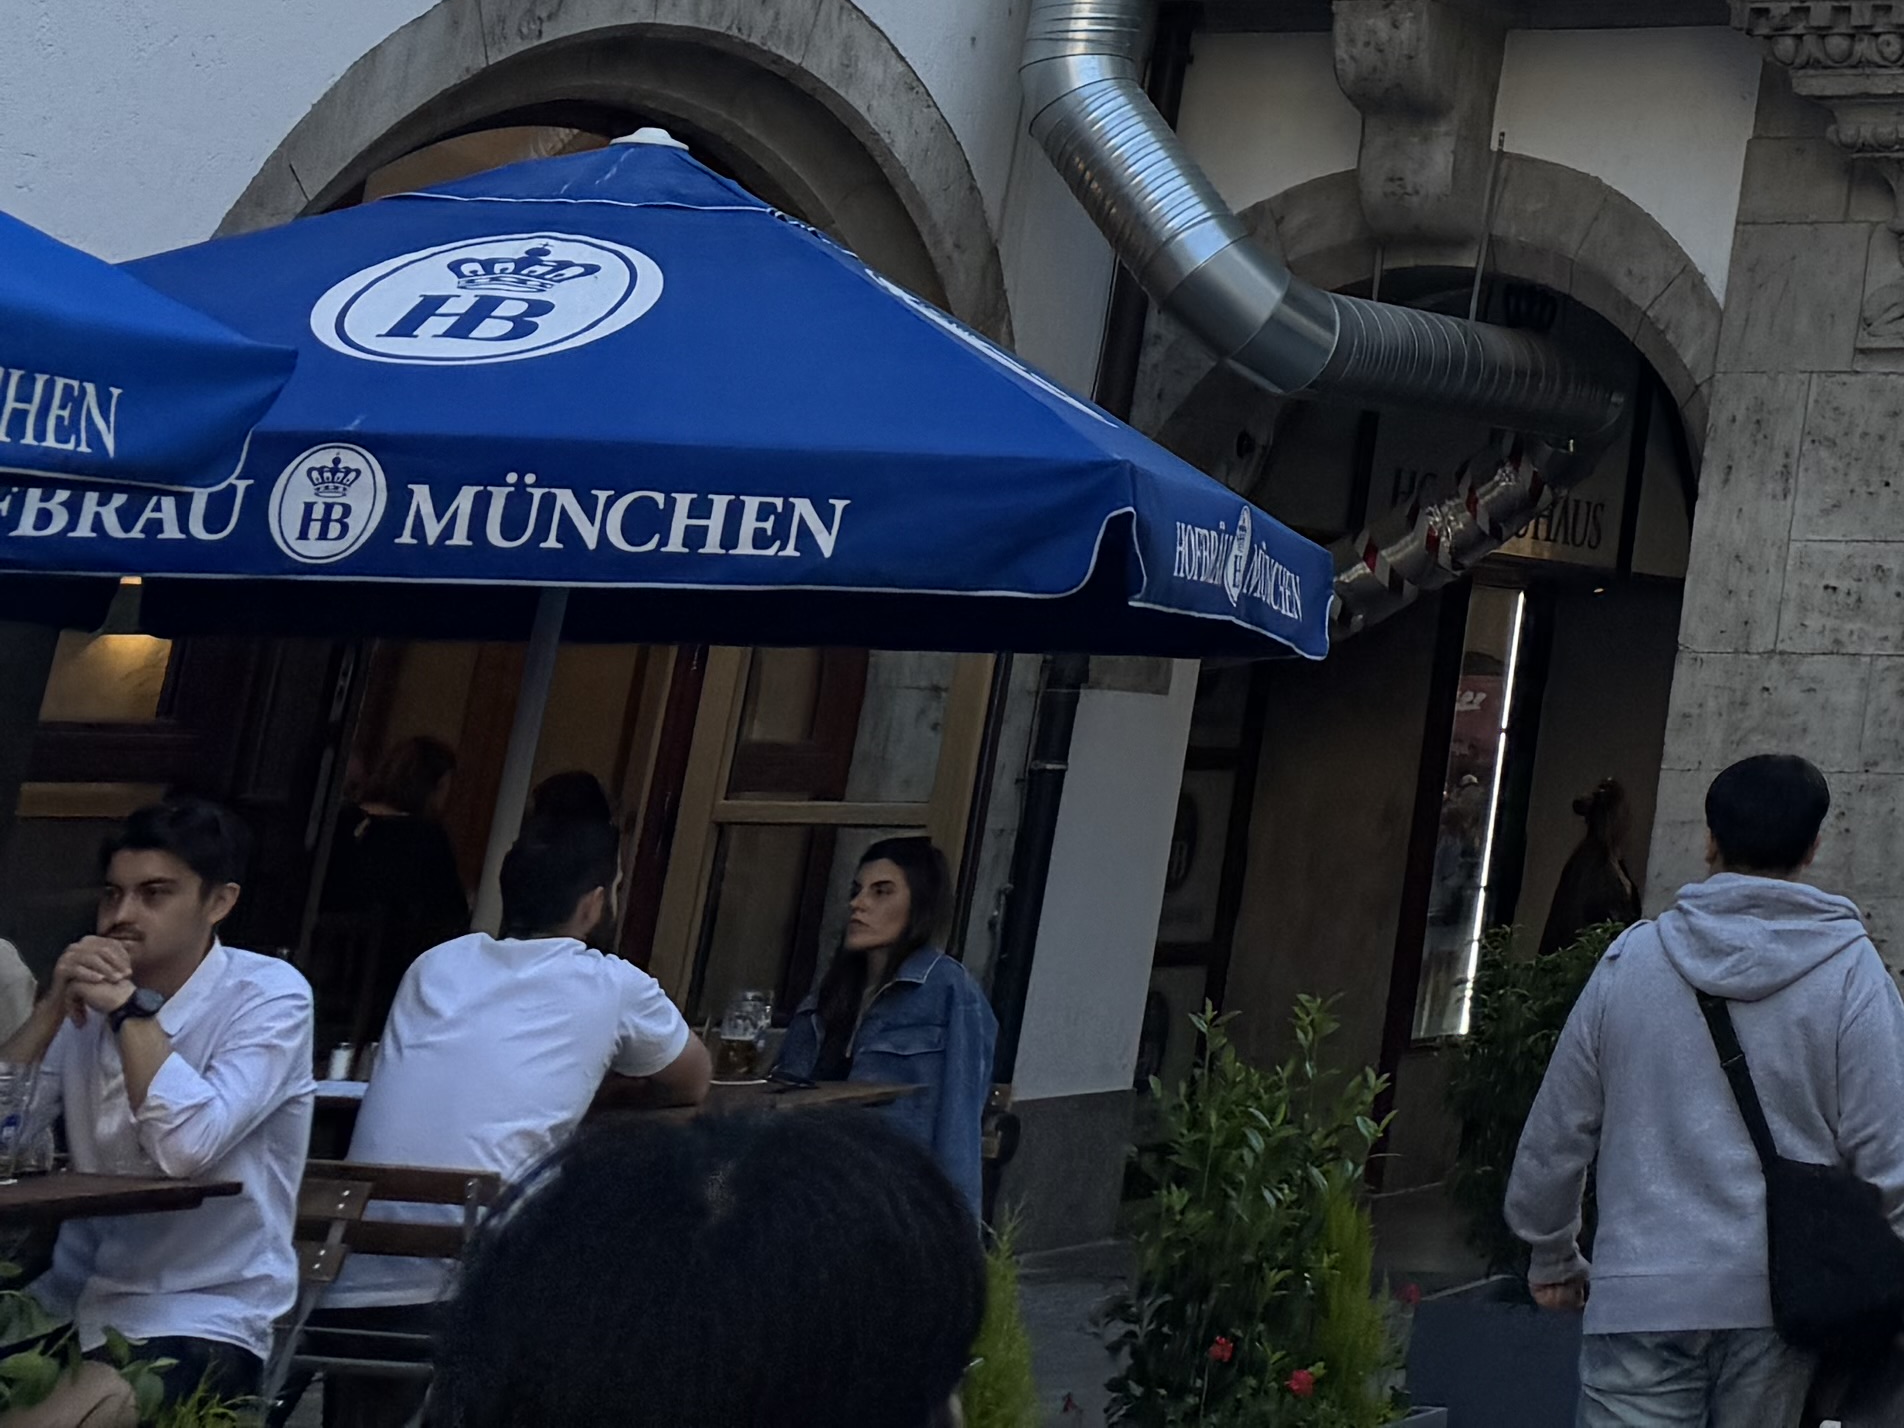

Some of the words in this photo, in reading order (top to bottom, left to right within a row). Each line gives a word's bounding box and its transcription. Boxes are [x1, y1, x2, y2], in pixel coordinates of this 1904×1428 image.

[375, 294, 556, 340] HB
[295, 501, 353, 542] HB
[393, 472, 851, 559] MÜNCHEN
